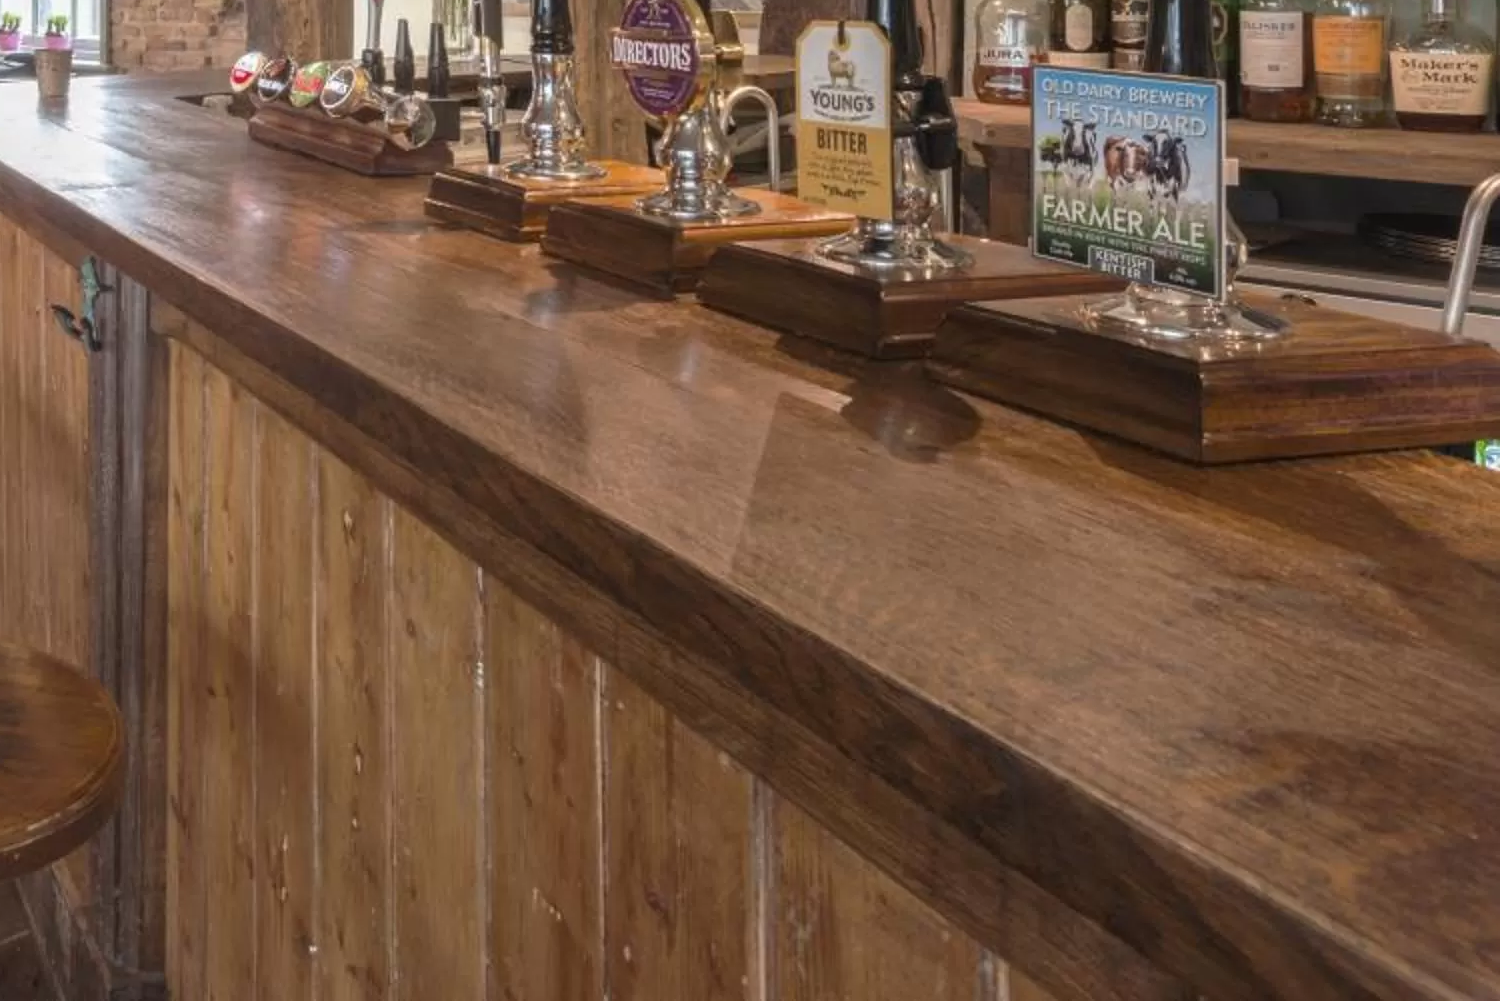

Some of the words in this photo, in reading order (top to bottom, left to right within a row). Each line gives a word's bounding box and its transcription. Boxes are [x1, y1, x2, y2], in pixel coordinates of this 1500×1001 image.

[612, 35, 692, 72] DIRECTORS
[983, 50, 1024, 61] JURA
[1421, 71, 1478, 85] Mark
[810, 88, 876, 112] YOUNG'S
[1041, 78, 1073, 95] OLD
[1077, 82, 1123, 101] DAIRY
[1129, 86, 1208, 109] BREWERY
[1043, 99, 1084, 120] THE
[1089, 104, 1207, 138] STANDARD
[816, 127, 867, 155] BITTER
[1043, 194, 1145, 237] FARMER
[1153, 216, 1206, 248] ALE
[1094, 249, 1148, 269] KENTISH
[1100, 262, 1142, 280] BITTER
